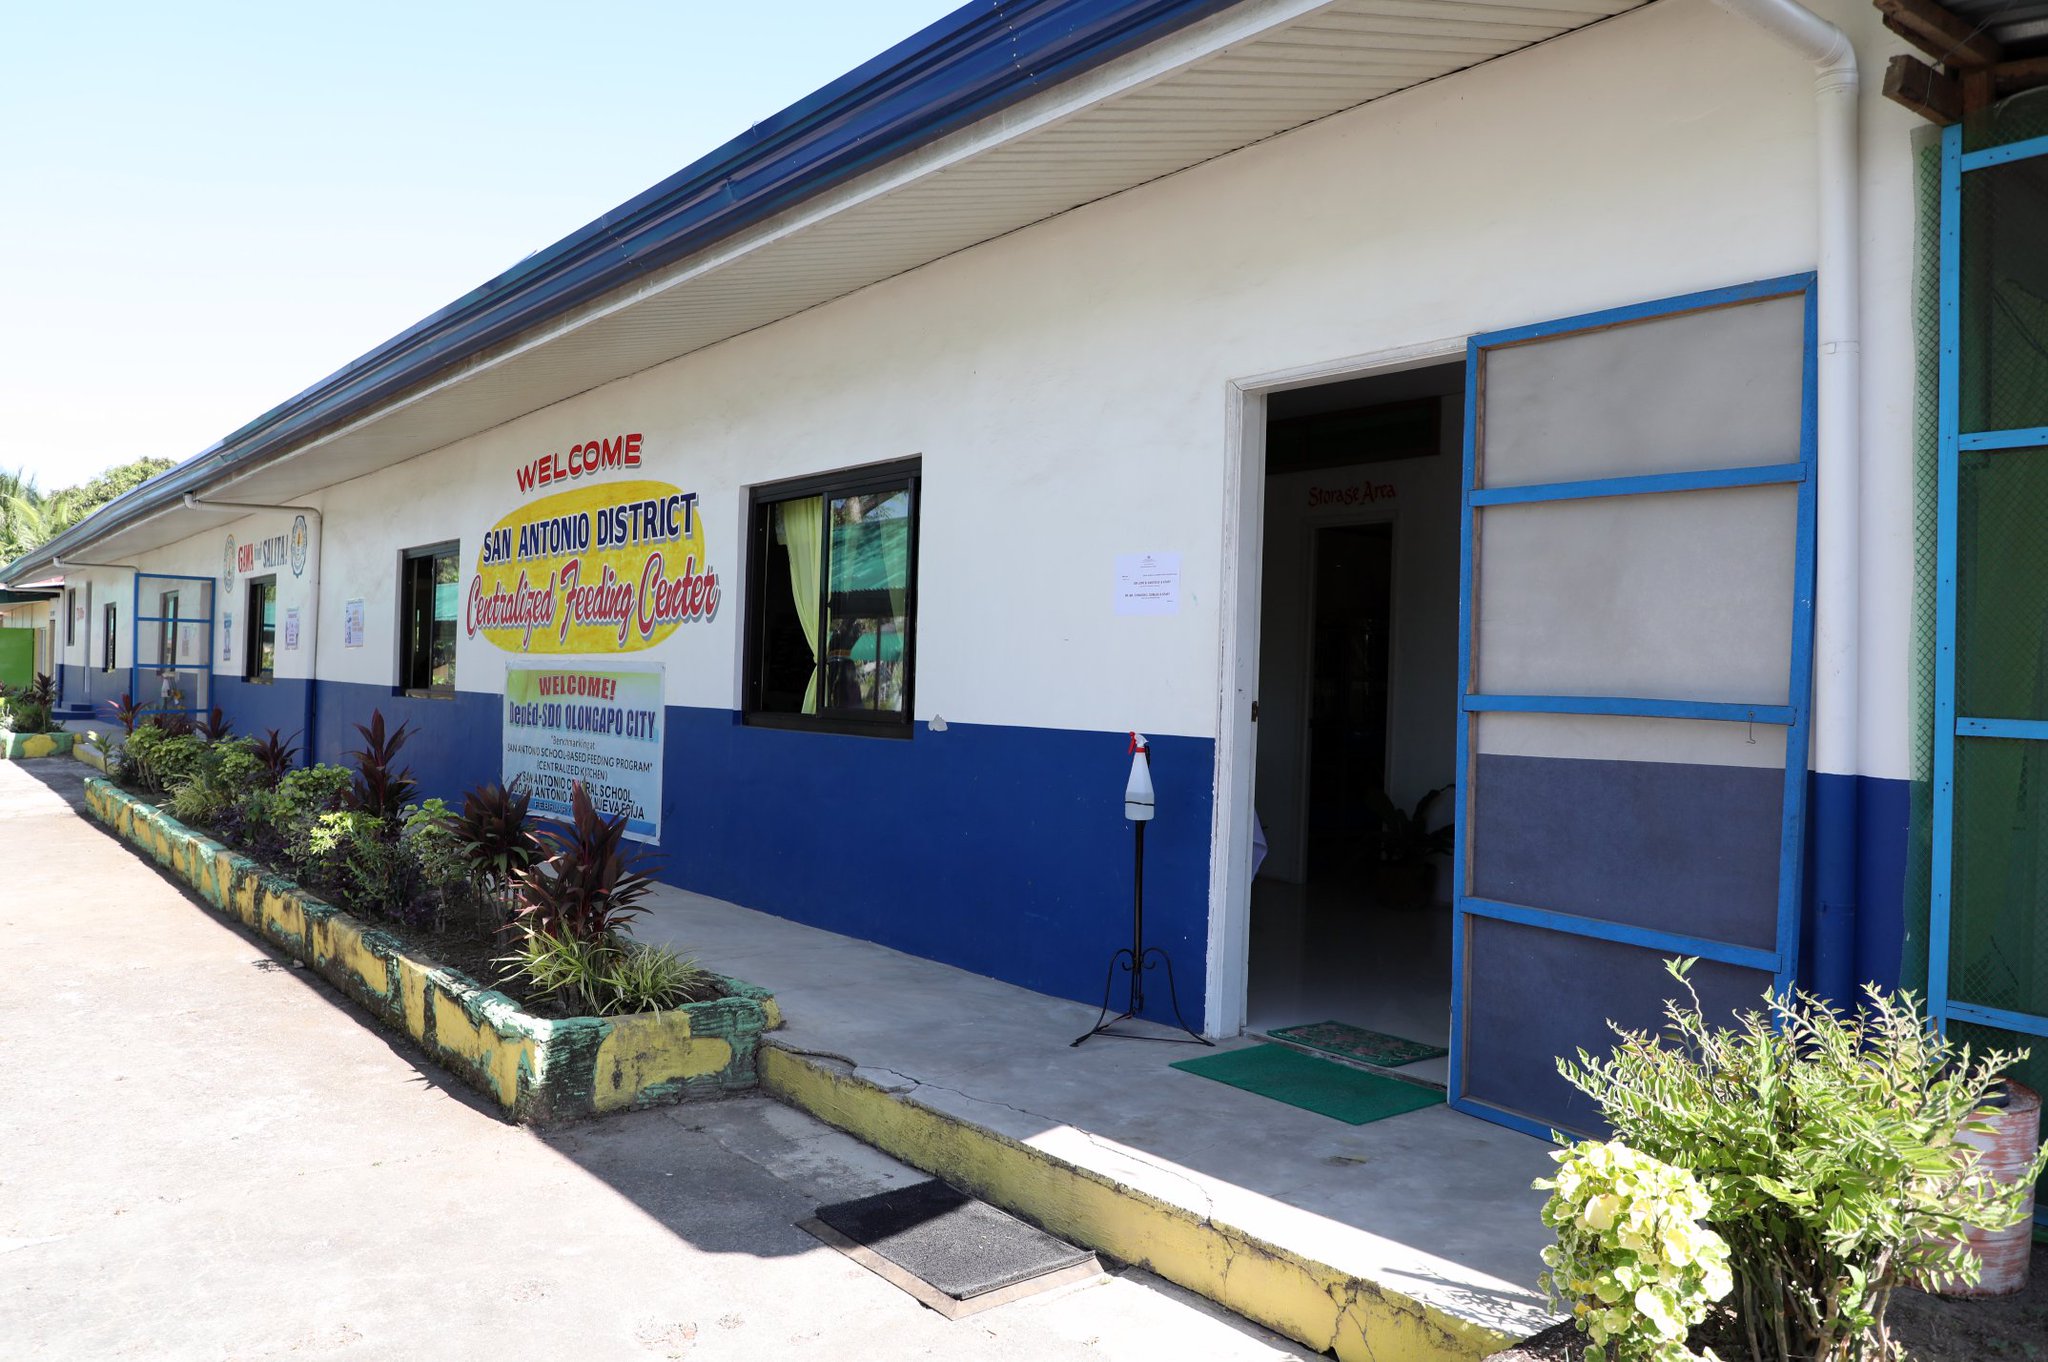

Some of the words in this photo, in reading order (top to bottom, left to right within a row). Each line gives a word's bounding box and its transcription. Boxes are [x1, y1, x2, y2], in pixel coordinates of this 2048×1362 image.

[517, 433, 643, 492] WELCOME
[1308, 485, 1360, 506] Storage
[1361, 480, 1396, 504] Area
[483, 528, 512, 563] SAN
[517, 512, 590, 559] ANTONIO
[597, 492, 698, 546] DISTRICT
[466, 570, 557, 648] Centralized
[559, 558, 635, 643] Feeding
[638, 552, 719, 636] Center
[539, 675, 617, 700] WELCOME!
[509, 701, 562, 728] DepEd-SDO
[565, 704, 623, 736] OLONGAPO
[626, 709, 656, 739] CITY
[587, 754, 615, 767] FEEDING
[534, 773, 566, 790] ANTONIO
[535, 786, 567, 802] ANTONIO
